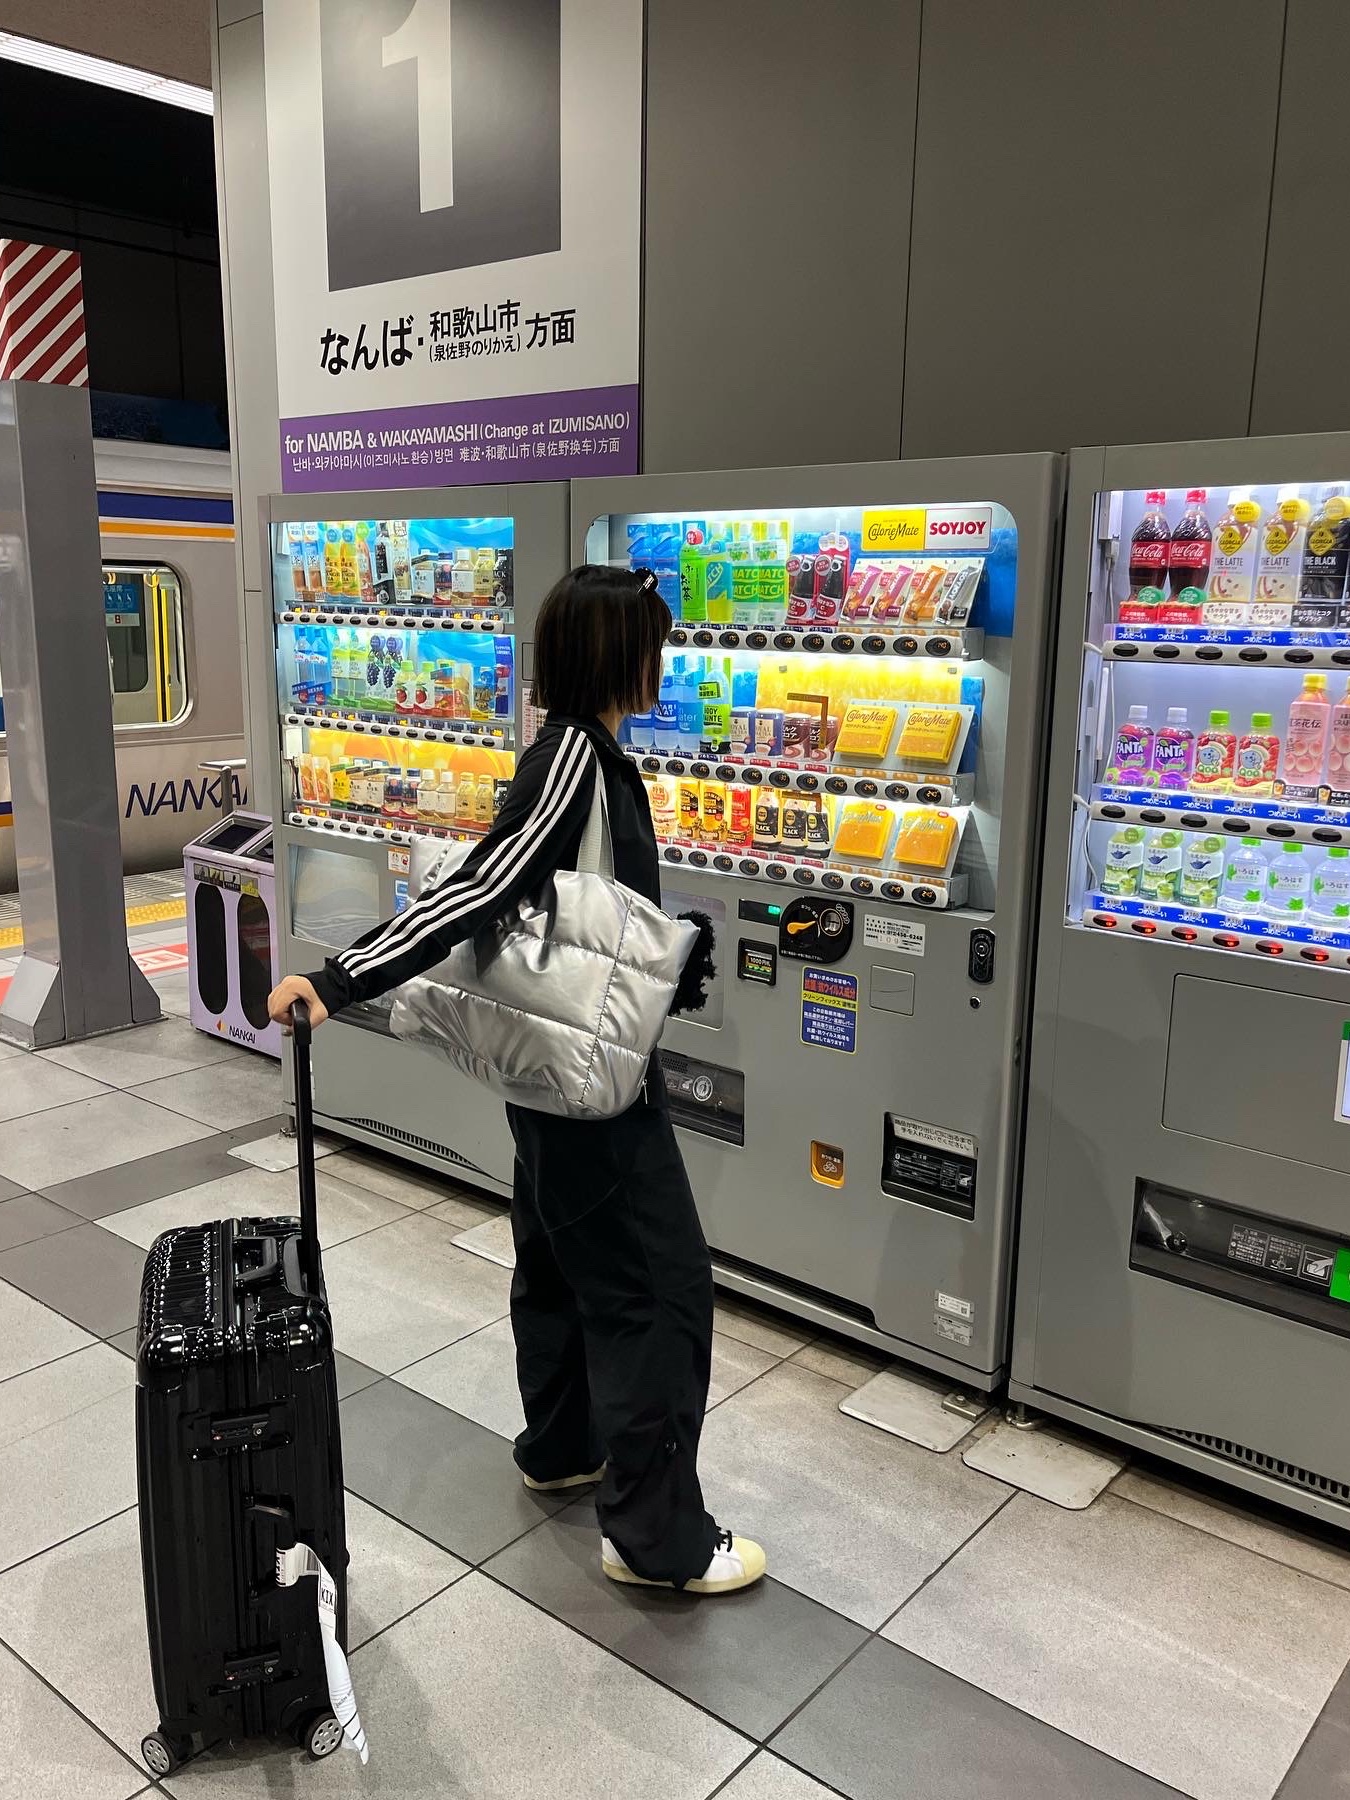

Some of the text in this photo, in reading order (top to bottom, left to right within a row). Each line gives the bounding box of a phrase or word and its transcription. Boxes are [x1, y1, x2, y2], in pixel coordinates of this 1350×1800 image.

[381, 0, 454, 213] 1
[429, 299, 521, 342] 和歌山市
[285, 435, 304, 455] for
[307, 429, 365, 453] NAMBA
[367, 432, 378, 449] &
[379, 424, 478, 448] WAKAYAMASHI
[532, 421, 545, 436] at
[549, 411, 630, 434] IZUMISANO)
[929, 521, 987, 535] SOYJOY
[1225, 558, 1244, 566] LATTE
[1271, 557, 1290, 566] LATTE
[1314, 557, 1337, 566] BLACK
[1116, 741, 1144, 754] FANTA
[1155, 745, 1184, 757] FANTA
[125, 775, 247, 819] NANKA
[229, 1025, 256, 1044] NANKAI
[321, 1588, 334, 1606] KIX
